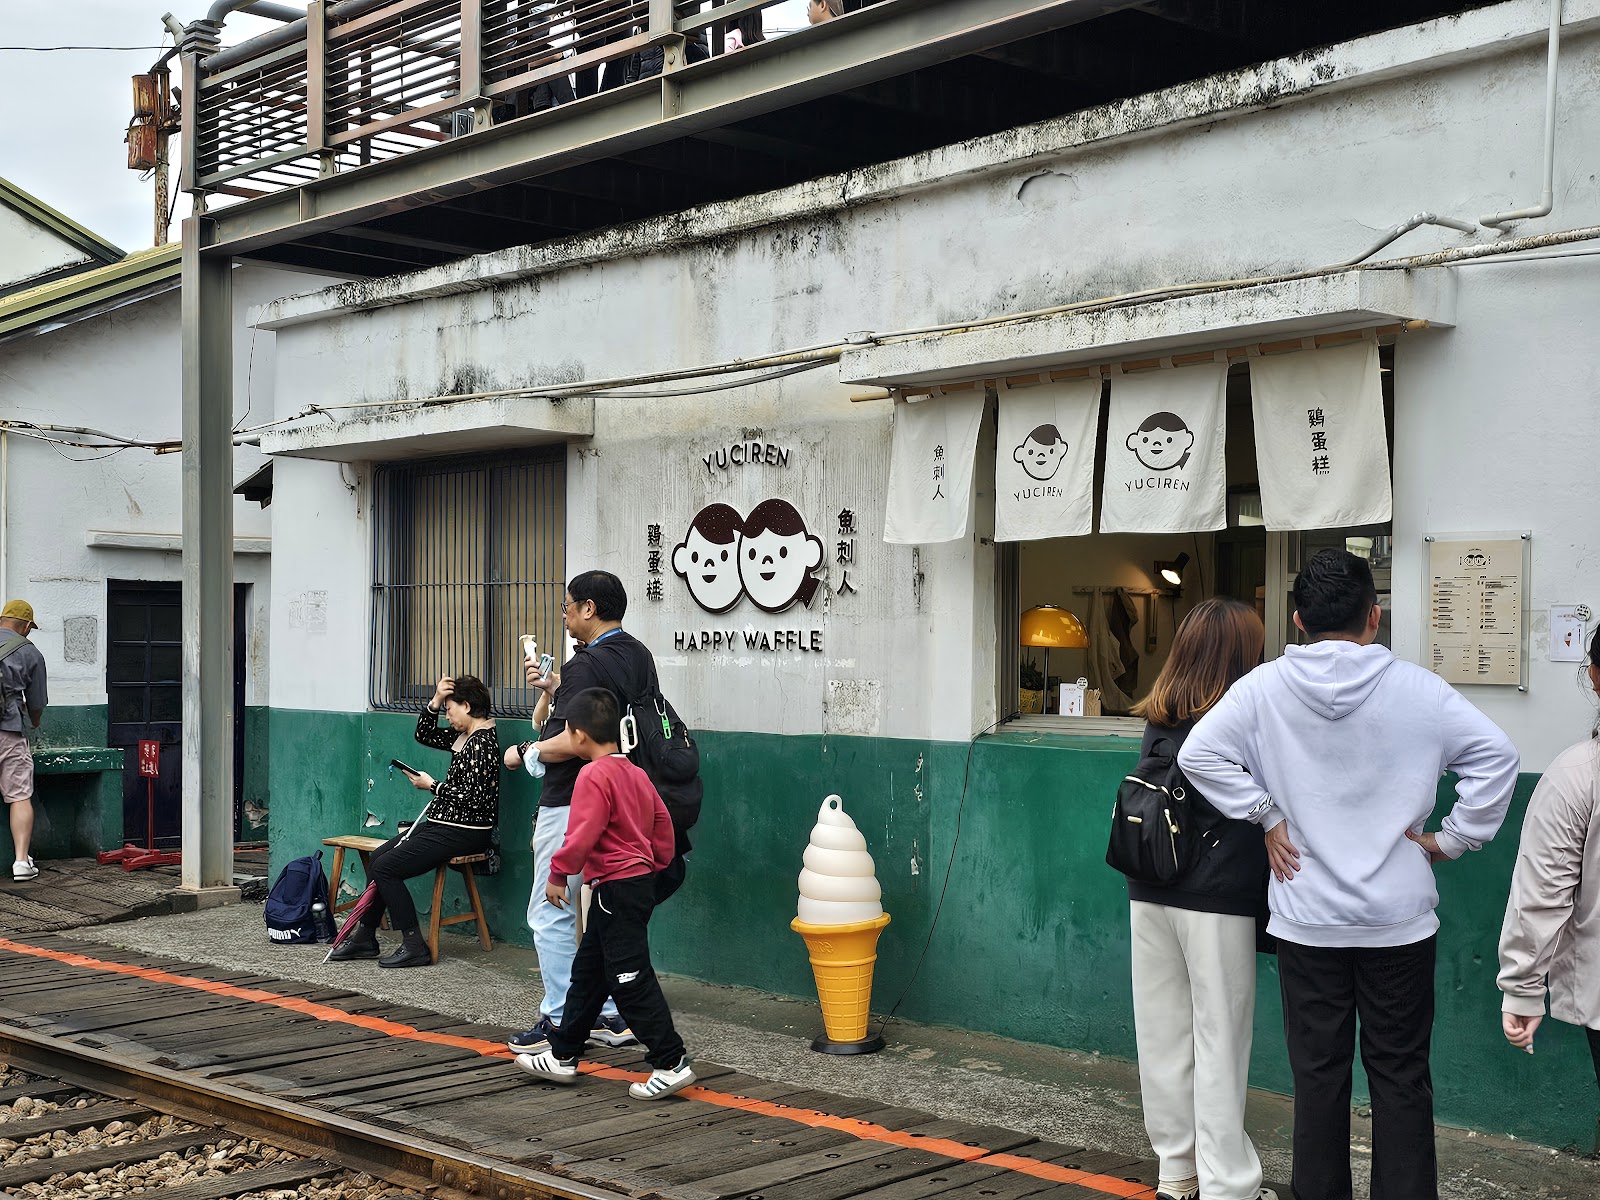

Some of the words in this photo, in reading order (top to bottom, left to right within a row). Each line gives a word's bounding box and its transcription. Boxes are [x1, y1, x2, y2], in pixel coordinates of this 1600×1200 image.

[702, 442, 791, 473] YUCIREN
[933, 444, 945, 501] 魚刺人
[1013, 486, 1063, 502] YUCIREN
[1124, 477, 1190, 492] YUCIREN
[836, 507, 858, 596] 魚刺人
[674, 630, 738, 651] HAPPY
[742, 630, 824, 652] WAFFLE
[267, 927, 292, 940] PUMA
